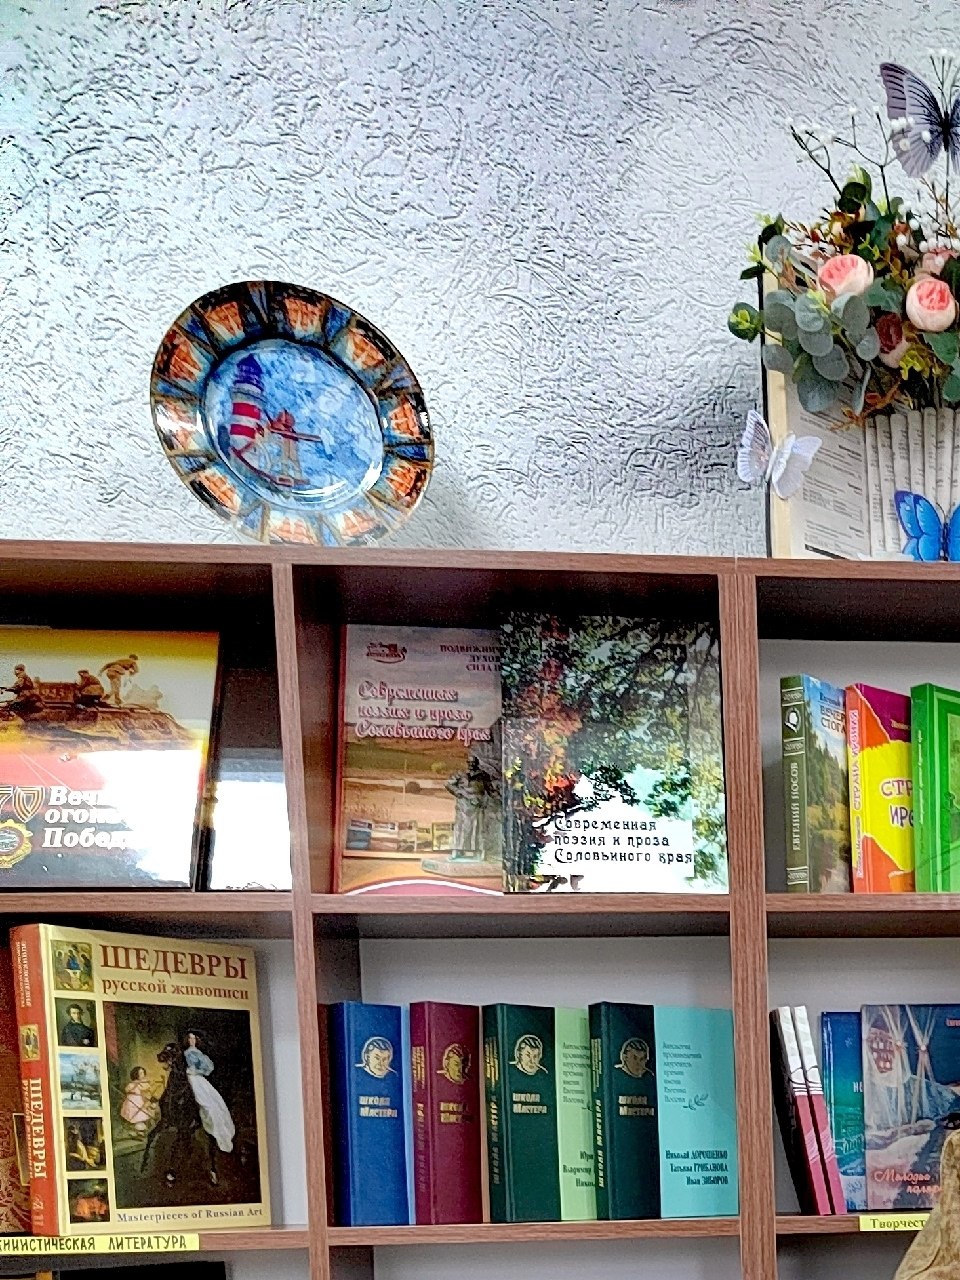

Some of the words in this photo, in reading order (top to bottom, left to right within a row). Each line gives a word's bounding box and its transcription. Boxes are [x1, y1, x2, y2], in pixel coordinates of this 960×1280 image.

[554, 815, 657, 831] Современная
[627, 836, 670, 848] проза
[554, 848, 651, 863] Соловьиного
[100, 944, 249, 980] ШЕДЕВРЫ
[102, 976, 168, 996] русской
[171, 983, 250, 1001] живописи
[29, 1077, 48, 1180] ШЕДЕВРЫ
[117, 1211, 190, 1224] Masterpieces
[191, 1210, 203, 1220] of
[206, 1207, 245, 1218] Russian
[247, 1207, 263, 1216] Art
[870, 1218, 925, 1231] Творчест
[108, 1234, 187, 1250] ЛИТЕРАТУРА
